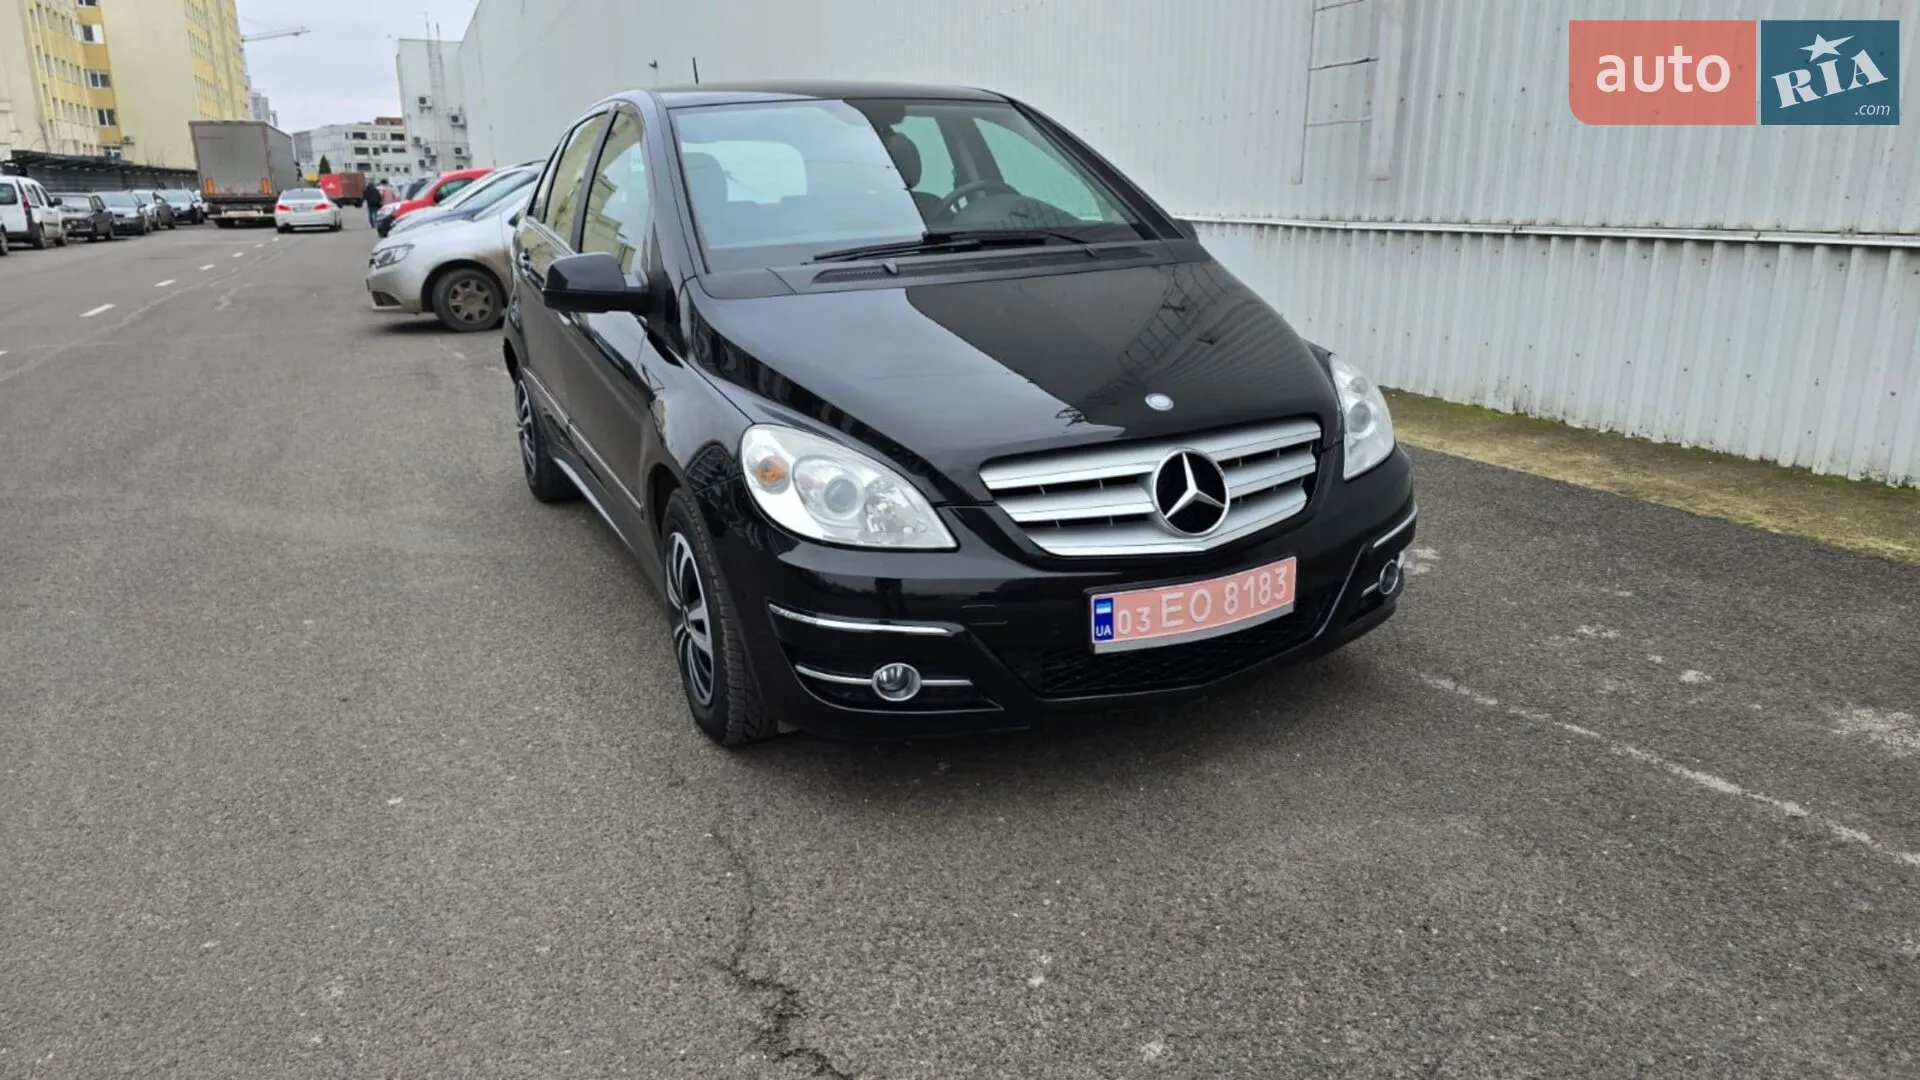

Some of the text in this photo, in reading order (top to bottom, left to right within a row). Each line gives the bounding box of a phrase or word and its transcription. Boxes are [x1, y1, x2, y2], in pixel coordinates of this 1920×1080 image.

[1117, 566, 1288, 635] 03 EO 8183
[1095, 624, 1112, 637] UA
